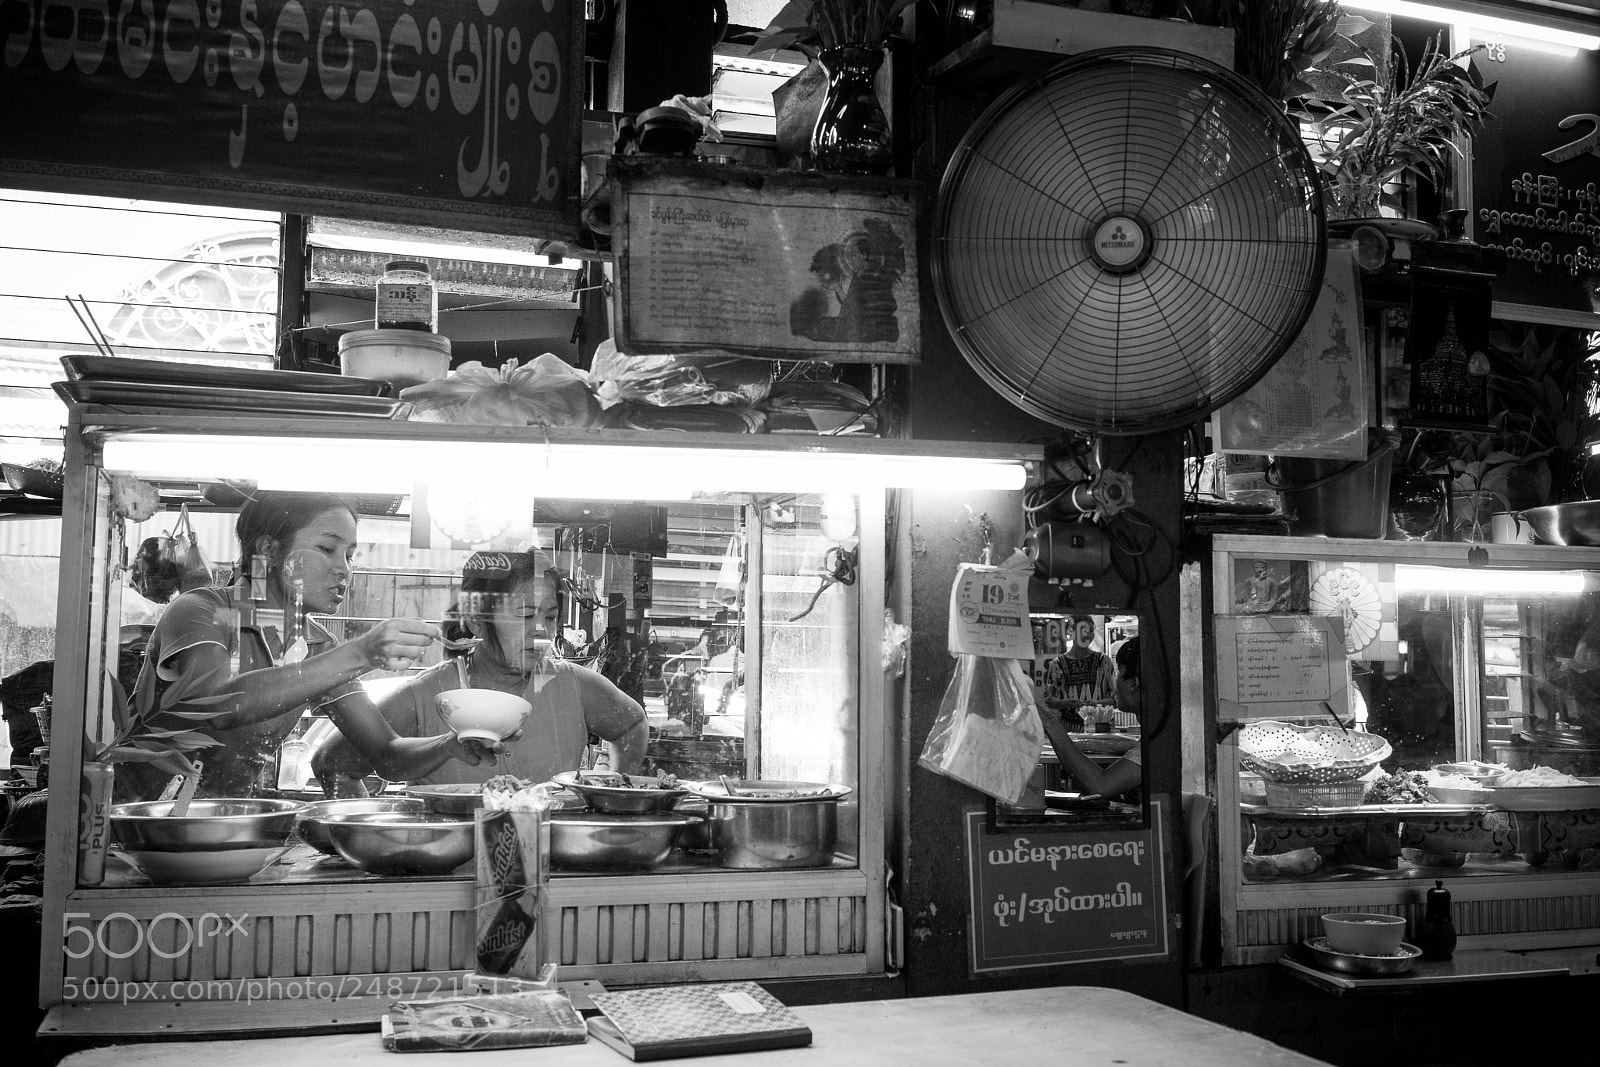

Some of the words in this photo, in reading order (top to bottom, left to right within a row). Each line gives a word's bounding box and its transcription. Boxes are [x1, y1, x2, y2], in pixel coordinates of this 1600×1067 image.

[982, 584, 1004, 605] 19
[92, 803, 105, 850] PLUS
[492, 822, 517, 896] Sunkist
[988, 838, 1144, 871] ယင်မနားစေရေး
